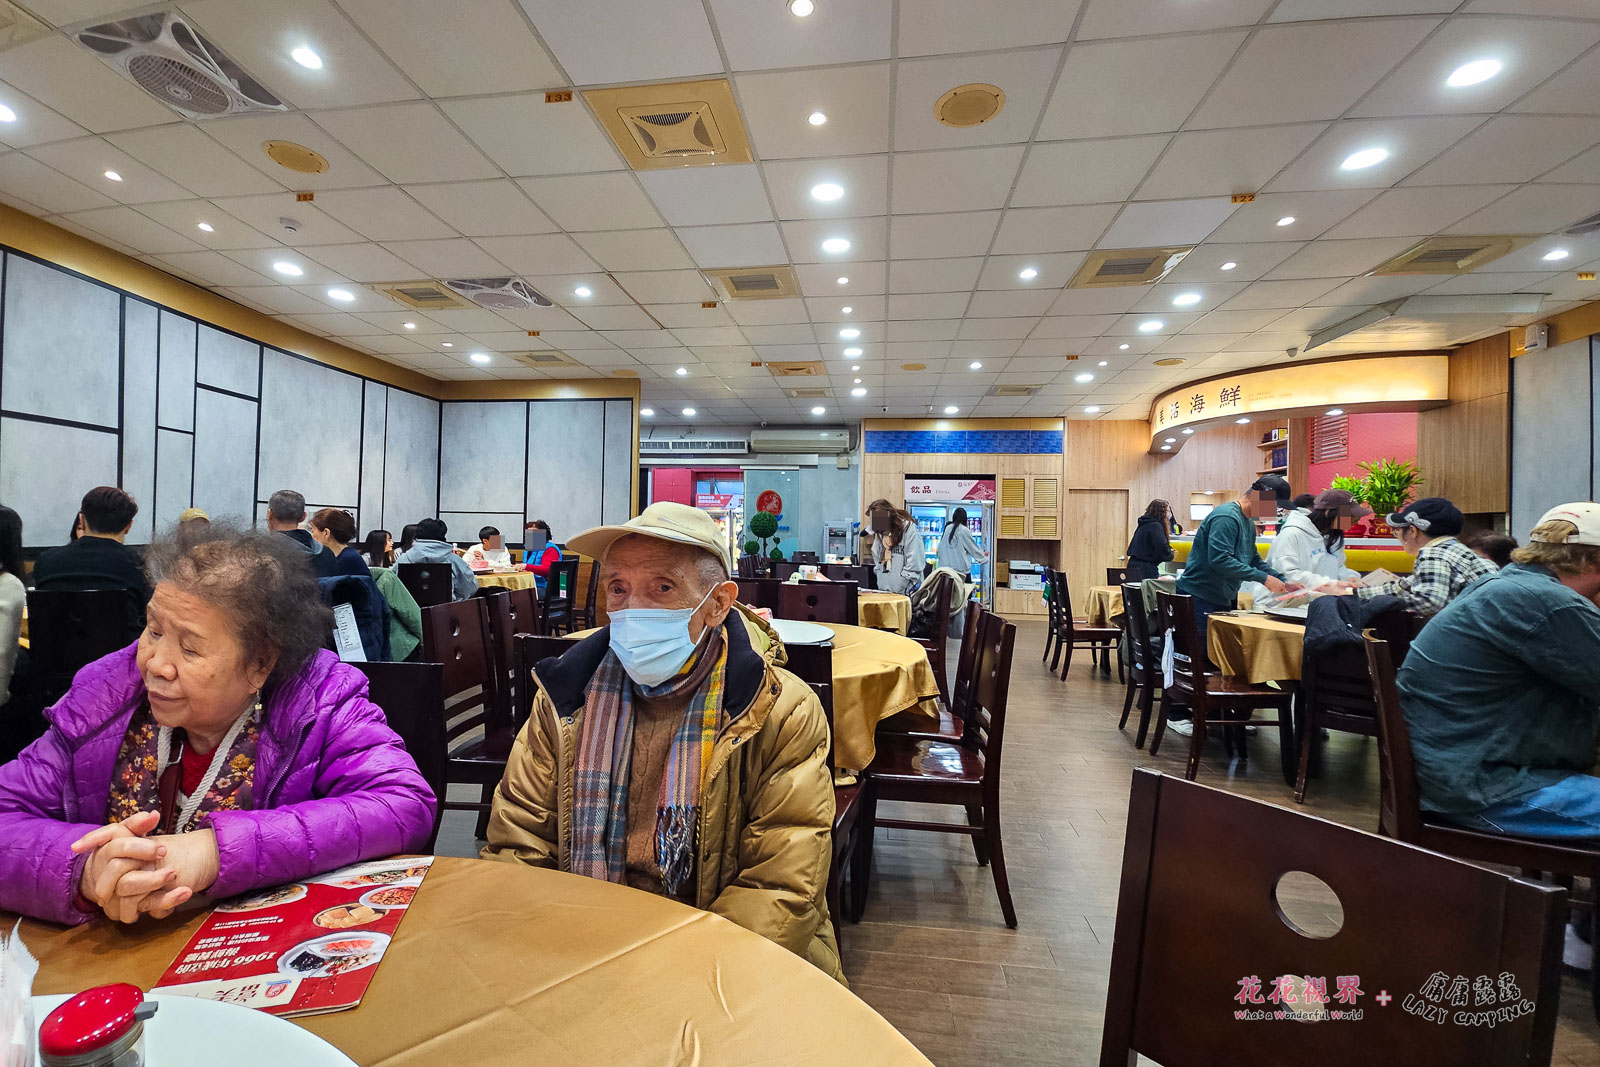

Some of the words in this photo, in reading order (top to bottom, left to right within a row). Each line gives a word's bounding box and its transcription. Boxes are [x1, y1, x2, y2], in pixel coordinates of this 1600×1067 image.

[545, 93, 572, 102] 133
[297, 194, 313, 202] 152
[1232, 195, 1255, 203] 122
[910, 485, 932, 494] 飲品
[231, 951, 276, 966] 1966
